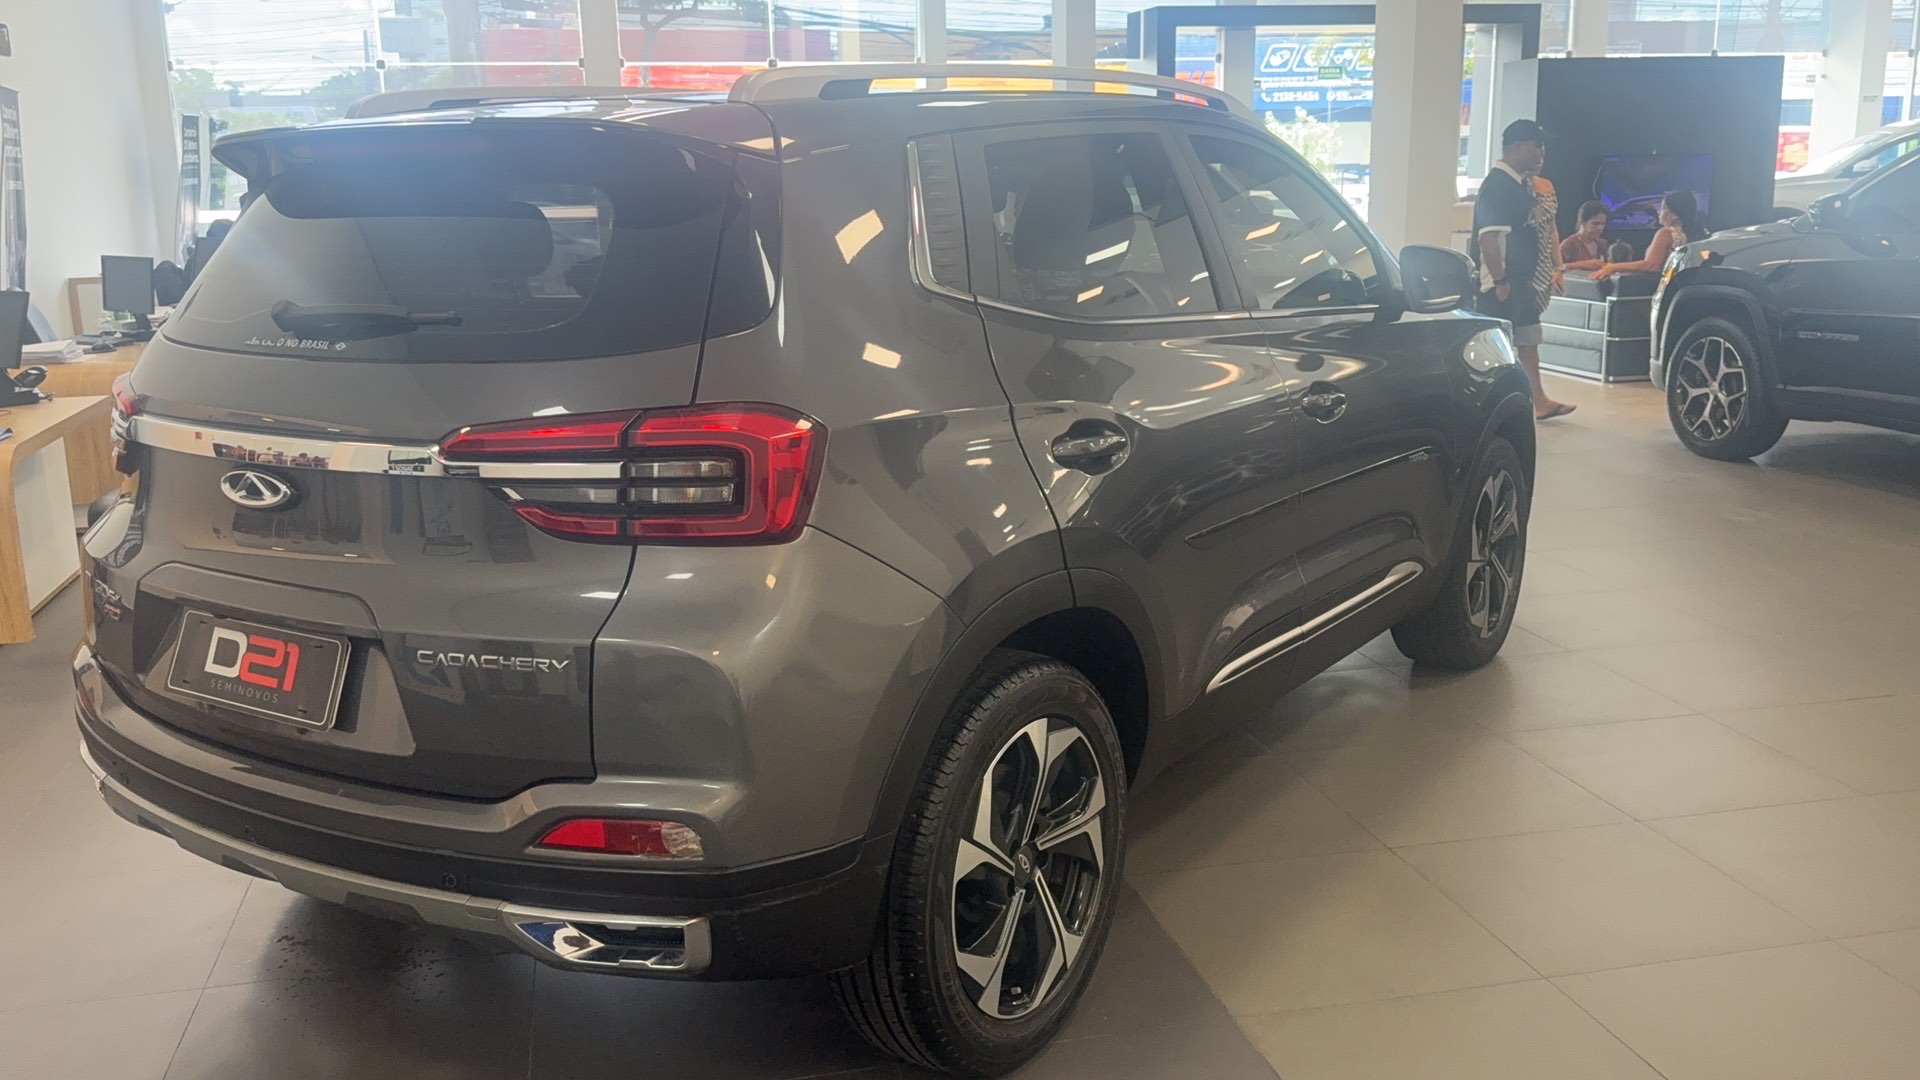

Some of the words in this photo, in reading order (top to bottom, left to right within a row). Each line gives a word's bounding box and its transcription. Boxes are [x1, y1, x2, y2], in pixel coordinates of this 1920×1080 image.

[284, 338, 299, 348] NO
[300, 339, 330, 350] BRASIL
[204, 626, 300, 692] D21
[210, 678, 280, 704] SEMINOVOS
